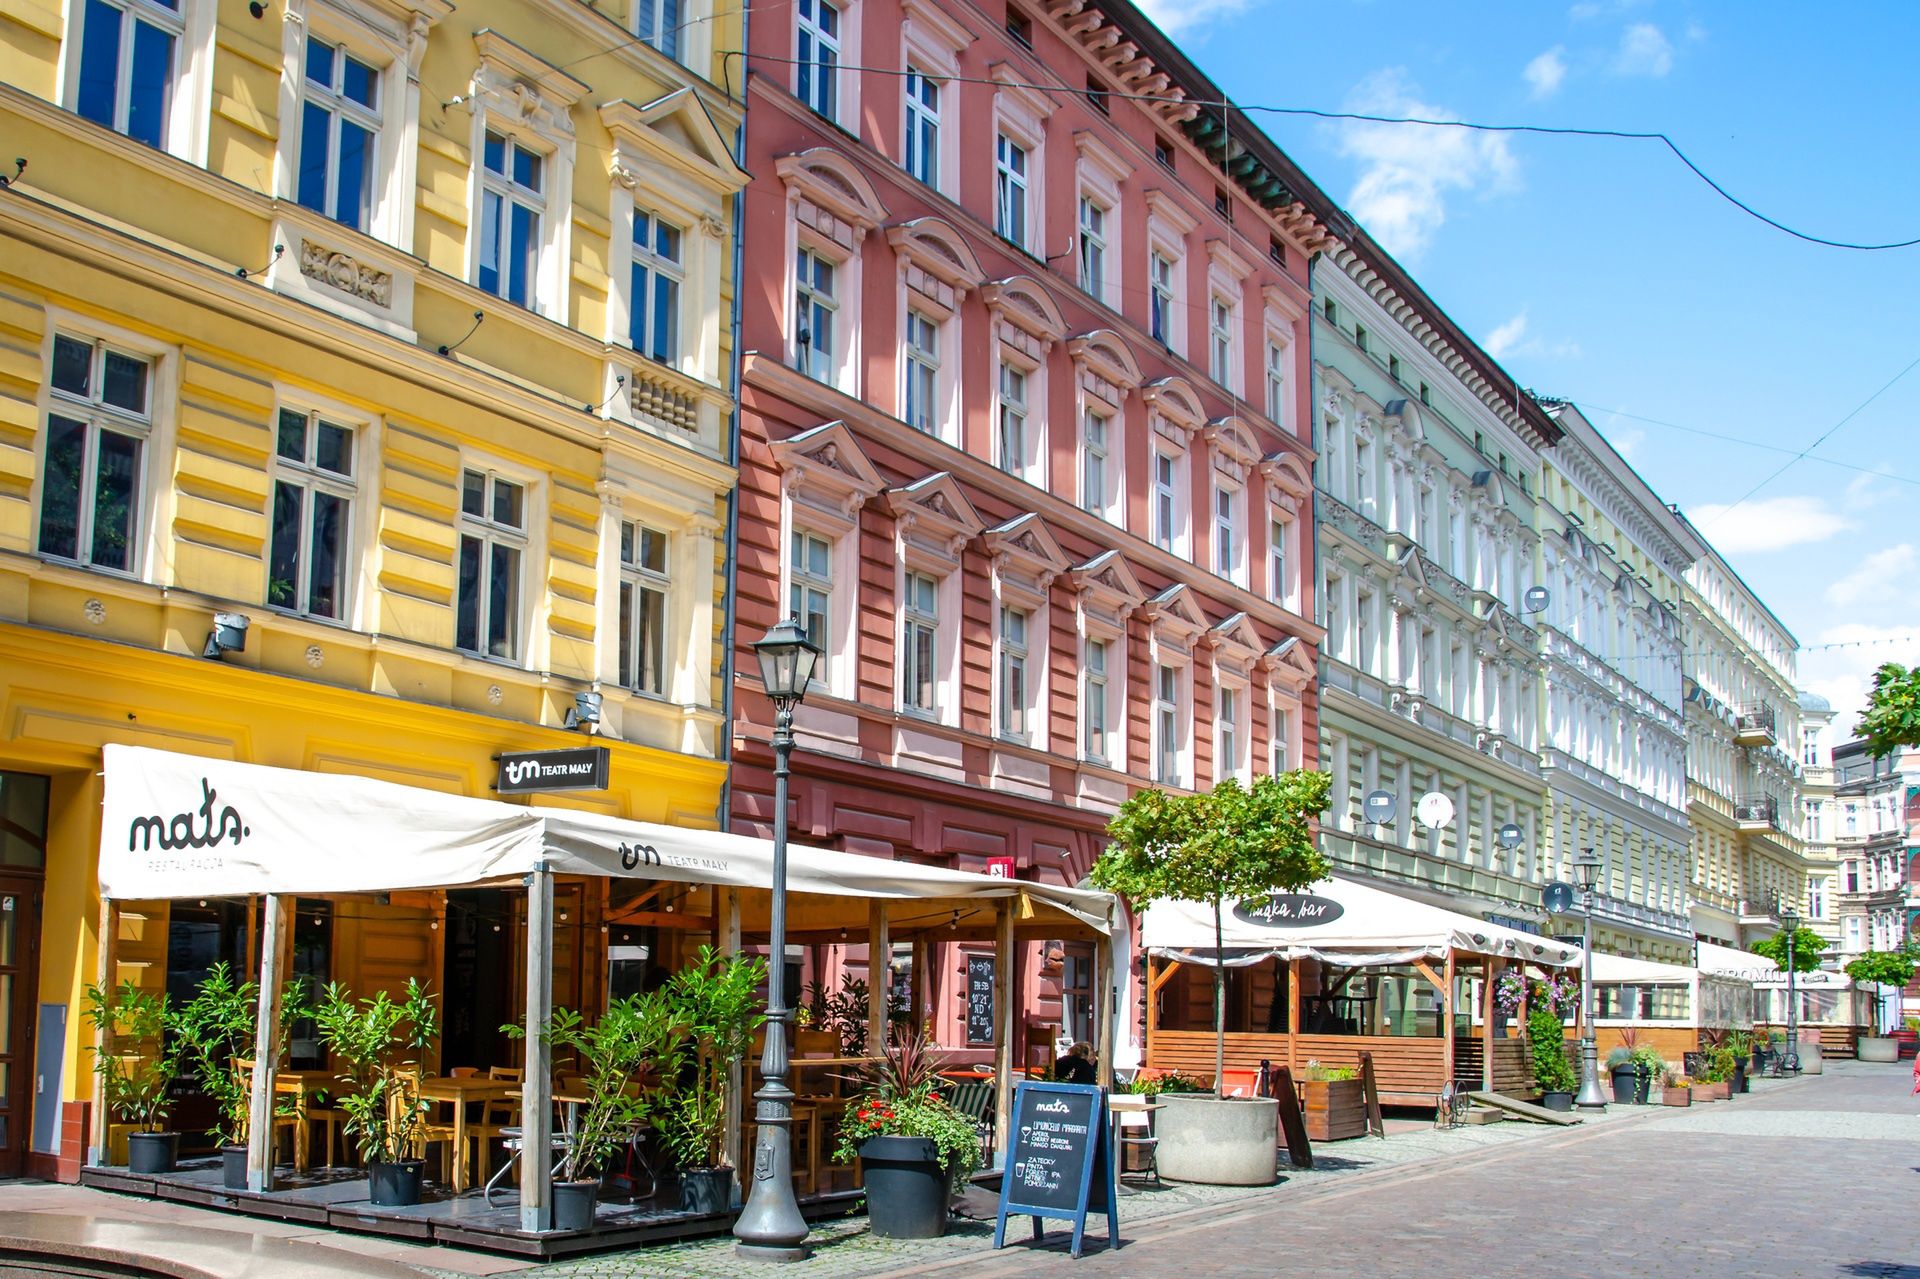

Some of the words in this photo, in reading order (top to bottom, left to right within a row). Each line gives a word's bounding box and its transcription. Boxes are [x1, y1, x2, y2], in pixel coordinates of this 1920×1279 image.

[541, 765, 568, 776] TEATR
[568, 763, 593, 775] MAŁY
[667, 855, 699, 867] TEATR
[1051, 1171, 1062, 1179] IPA
